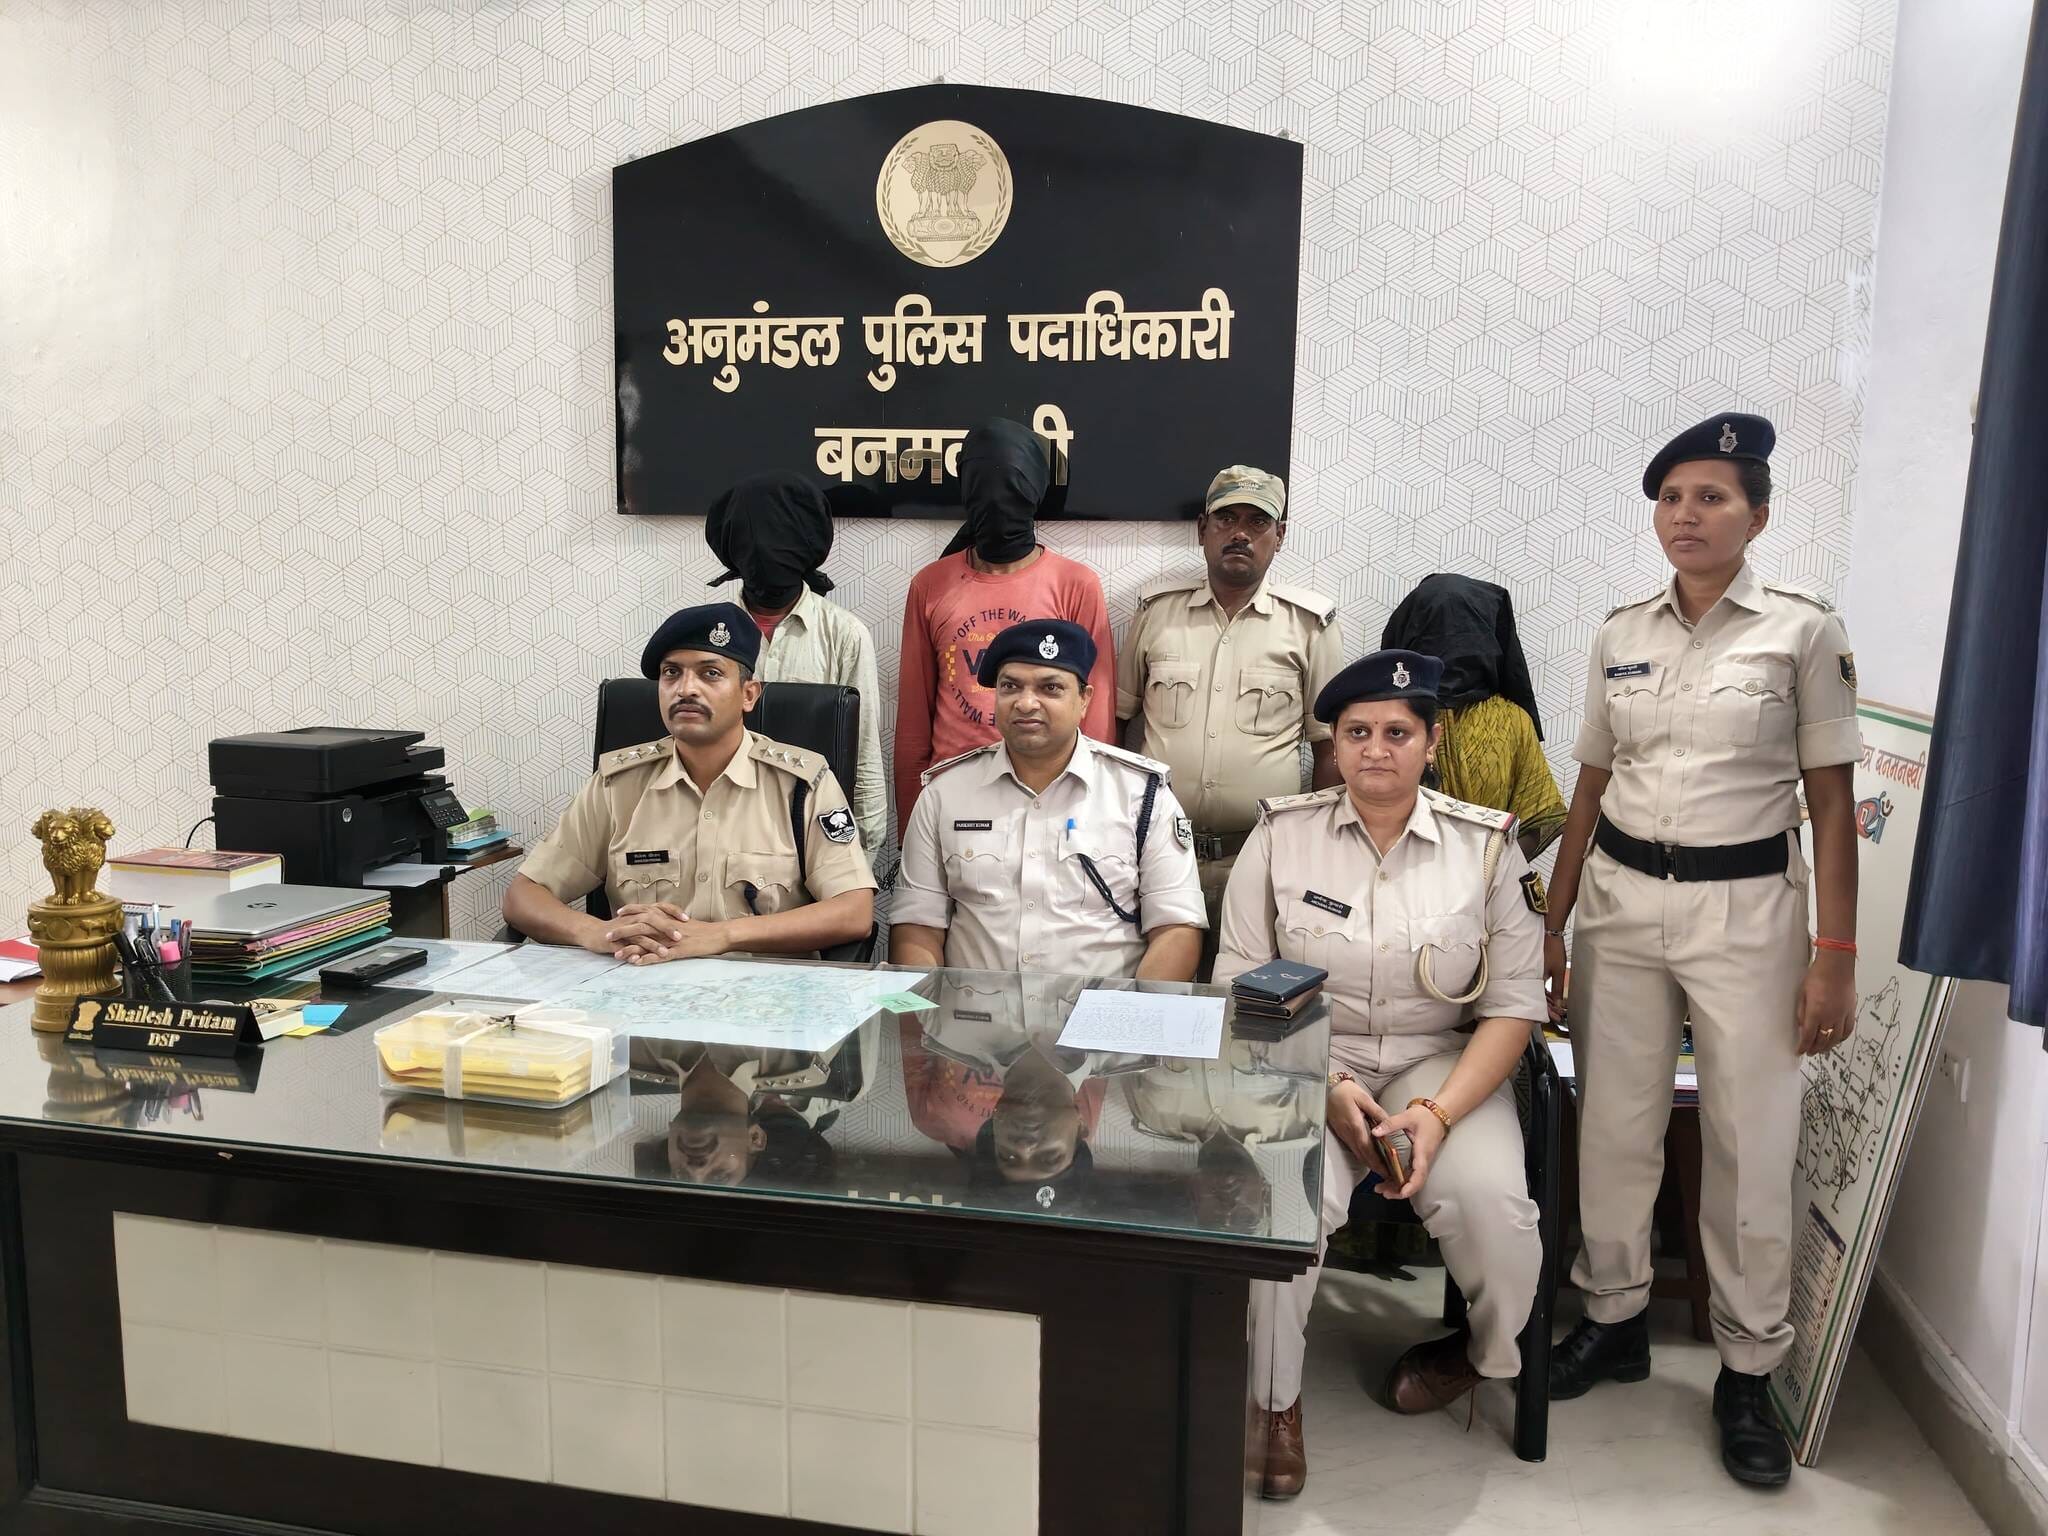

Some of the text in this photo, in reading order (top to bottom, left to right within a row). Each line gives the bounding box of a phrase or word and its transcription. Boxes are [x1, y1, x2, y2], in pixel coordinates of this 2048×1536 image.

[662, 287, 1235, 393] अनुमंडल पुलिस पदाधिकारी
[981, 608, 1004, 622] THE
[104, 1002, 237, 1031] Shailesh Pritam
[148, 1032, 181, 1048] DSP
